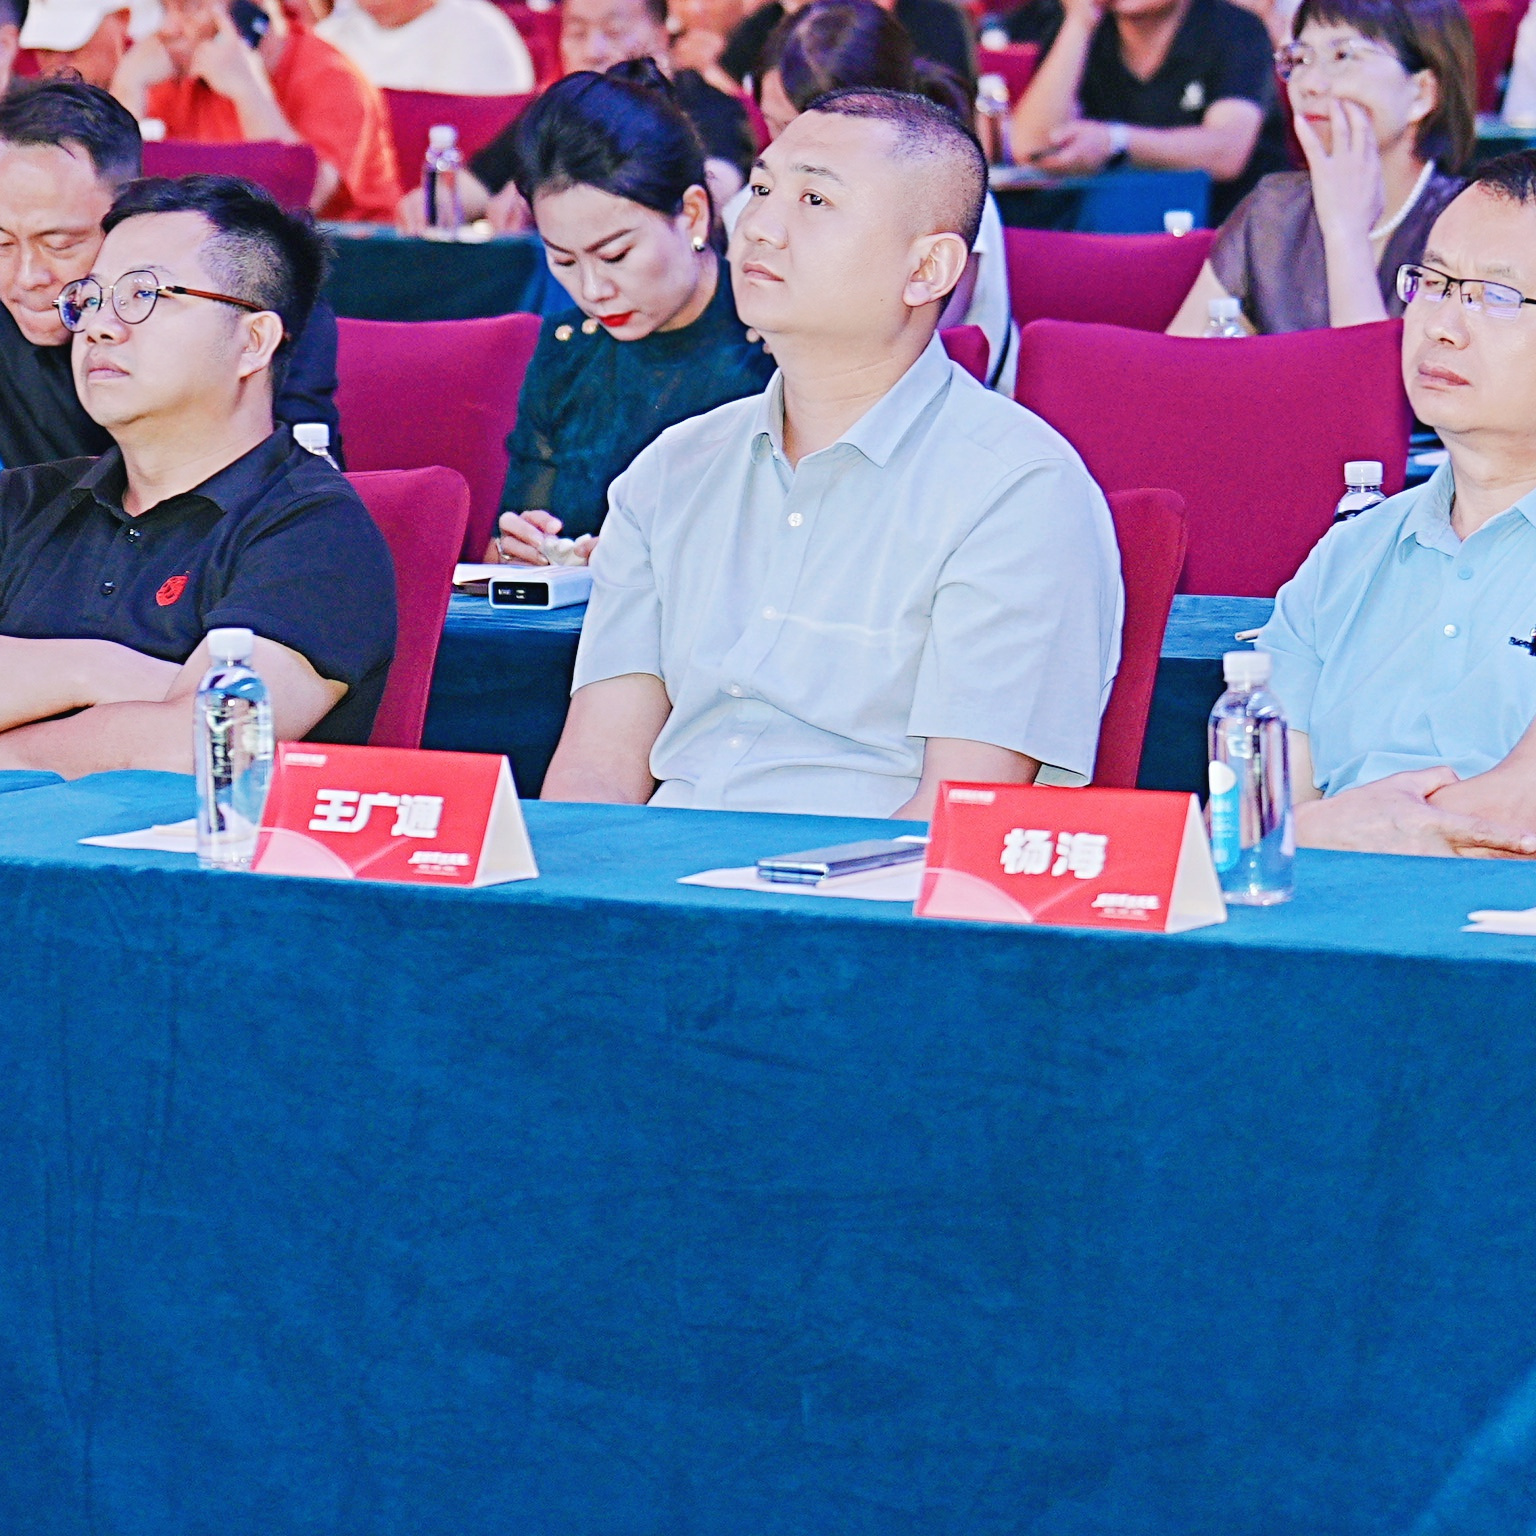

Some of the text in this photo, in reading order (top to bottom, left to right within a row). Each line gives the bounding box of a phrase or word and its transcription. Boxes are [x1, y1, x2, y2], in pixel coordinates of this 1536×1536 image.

[308, 788, 444, 839] 王广通
[999, 827, 1109, 880] 杨海
